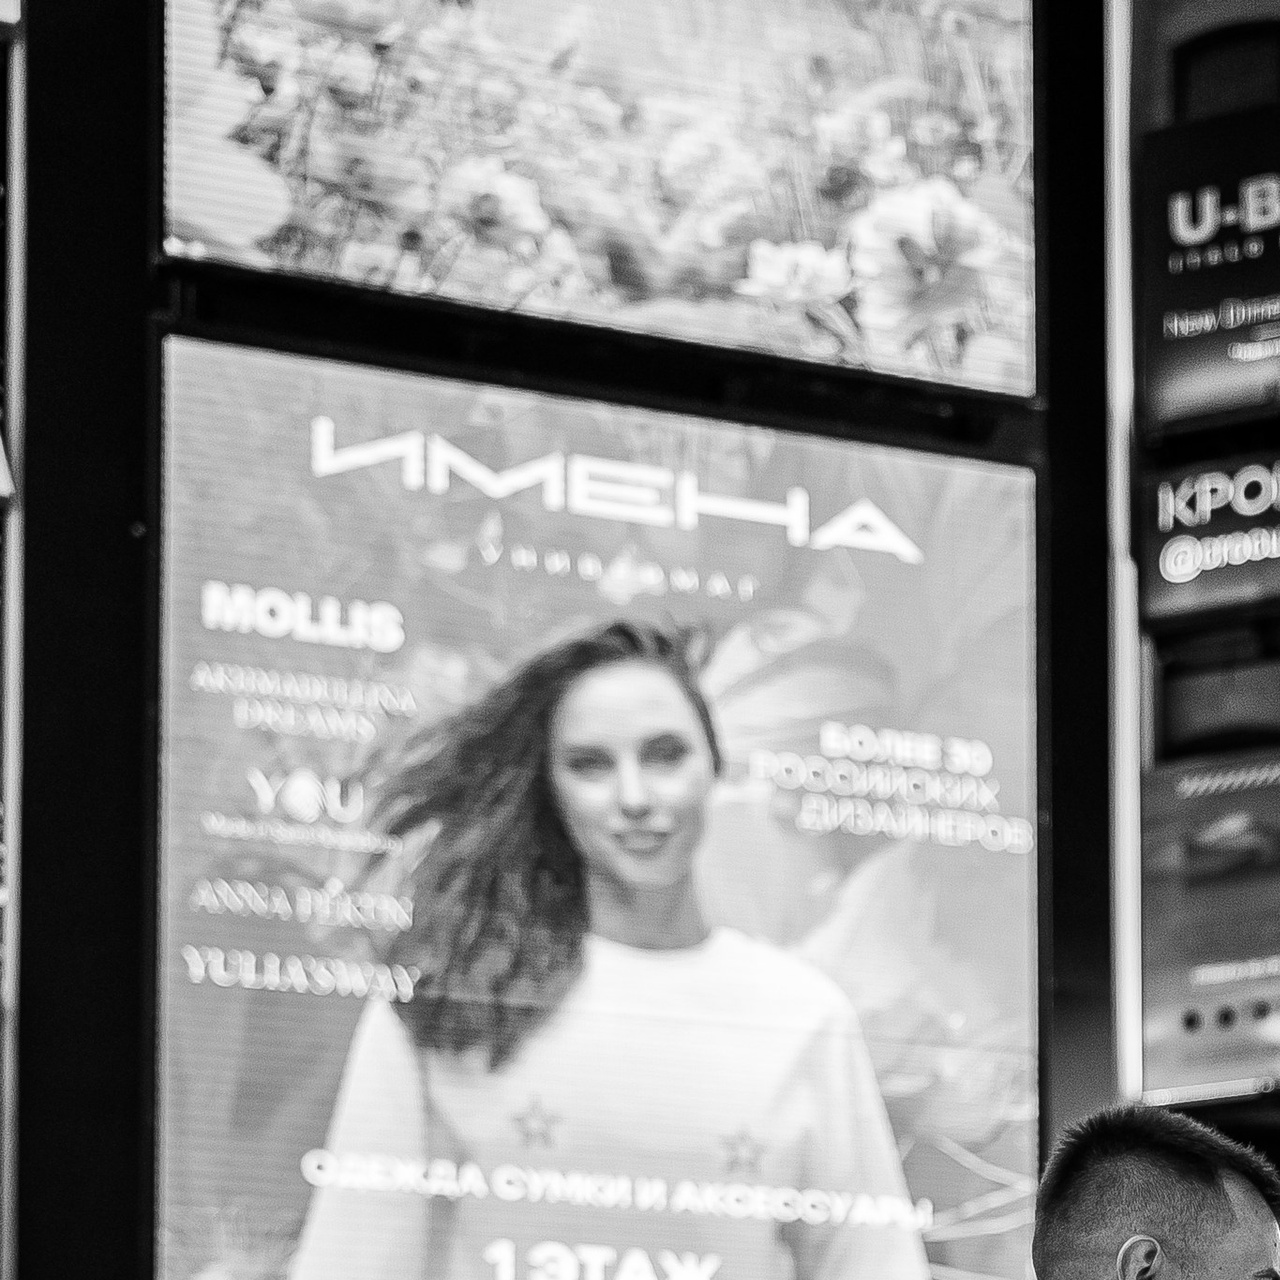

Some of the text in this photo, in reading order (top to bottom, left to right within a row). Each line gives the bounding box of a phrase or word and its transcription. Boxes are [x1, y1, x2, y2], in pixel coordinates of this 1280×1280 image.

[311, 415, 924, 565] ИМЕНА
[202, 580, 405, 653] MOLLIS
[819, 720, 943, 770] БОЛЕЕ
